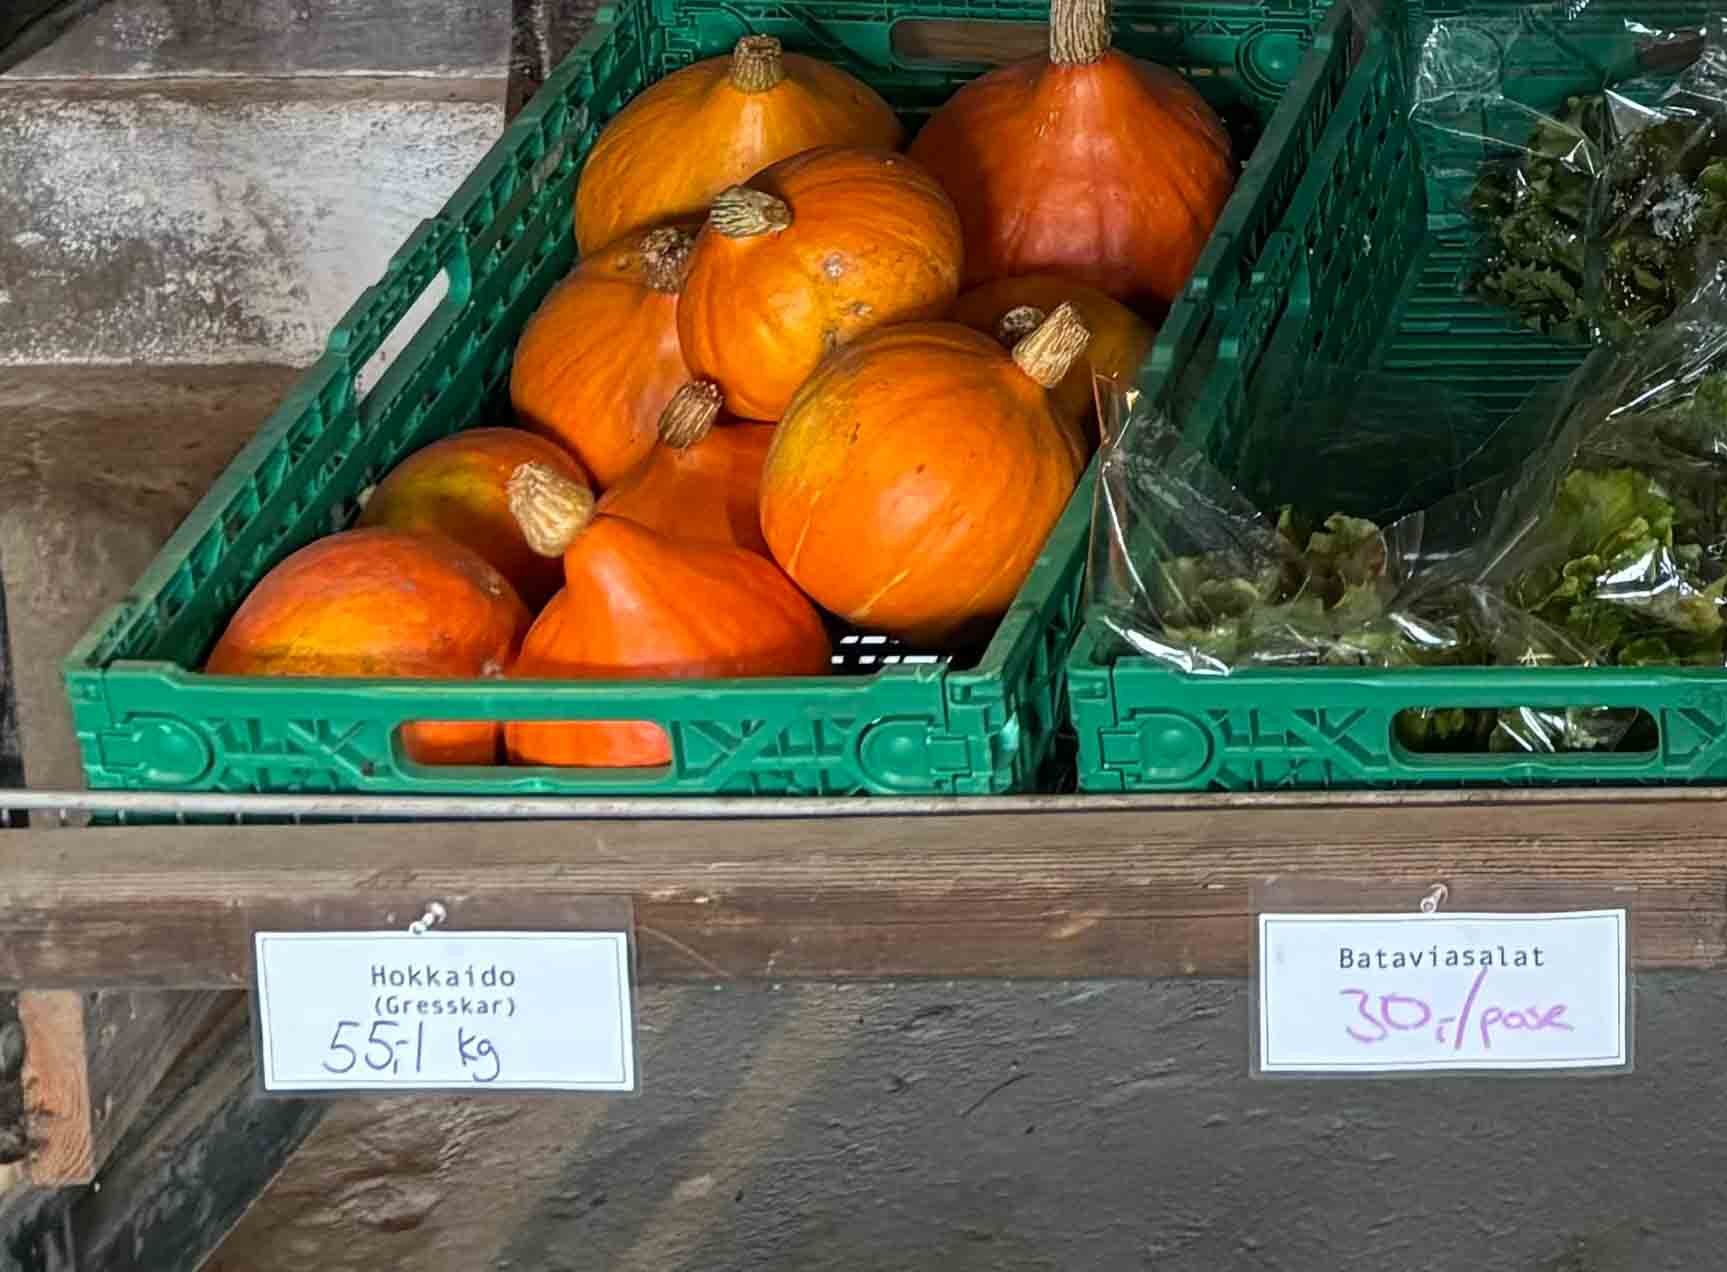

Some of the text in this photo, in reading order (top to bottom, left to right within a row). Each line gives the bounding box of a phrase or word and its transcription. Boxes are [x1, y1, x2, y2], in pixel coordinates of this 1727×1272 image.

[1338, 946, 1546, 971] Bataviasalat
[370, 963, 517, 988] Hokkaido
[373, 995, 518, 1019] (Gresskar)
